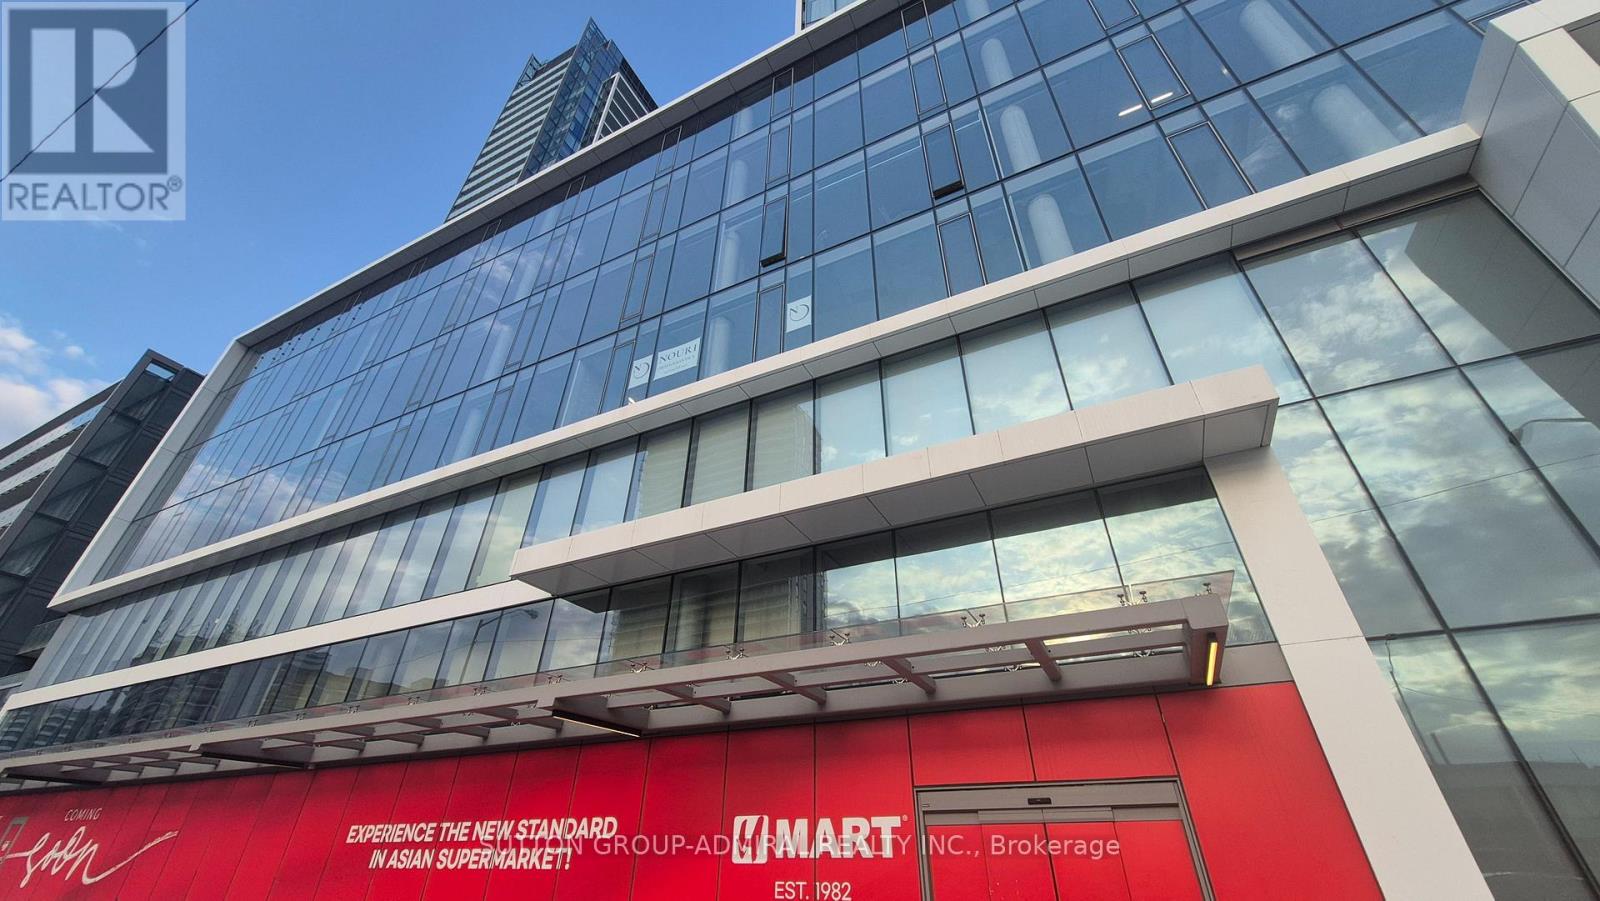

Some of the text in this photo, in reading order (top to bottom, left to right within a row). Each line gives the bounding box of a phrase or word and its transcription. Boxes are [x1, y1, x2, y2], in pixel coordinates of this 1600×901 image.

[64, 808, 102, 821] COMING
[346, 816, 618, 843] EXPERIENCE THE NEW STANDARD
[368, 847, 573, 870] IN ASIAN SUPERMARKET!
[774, 881, 852, 901] EST. 1982
